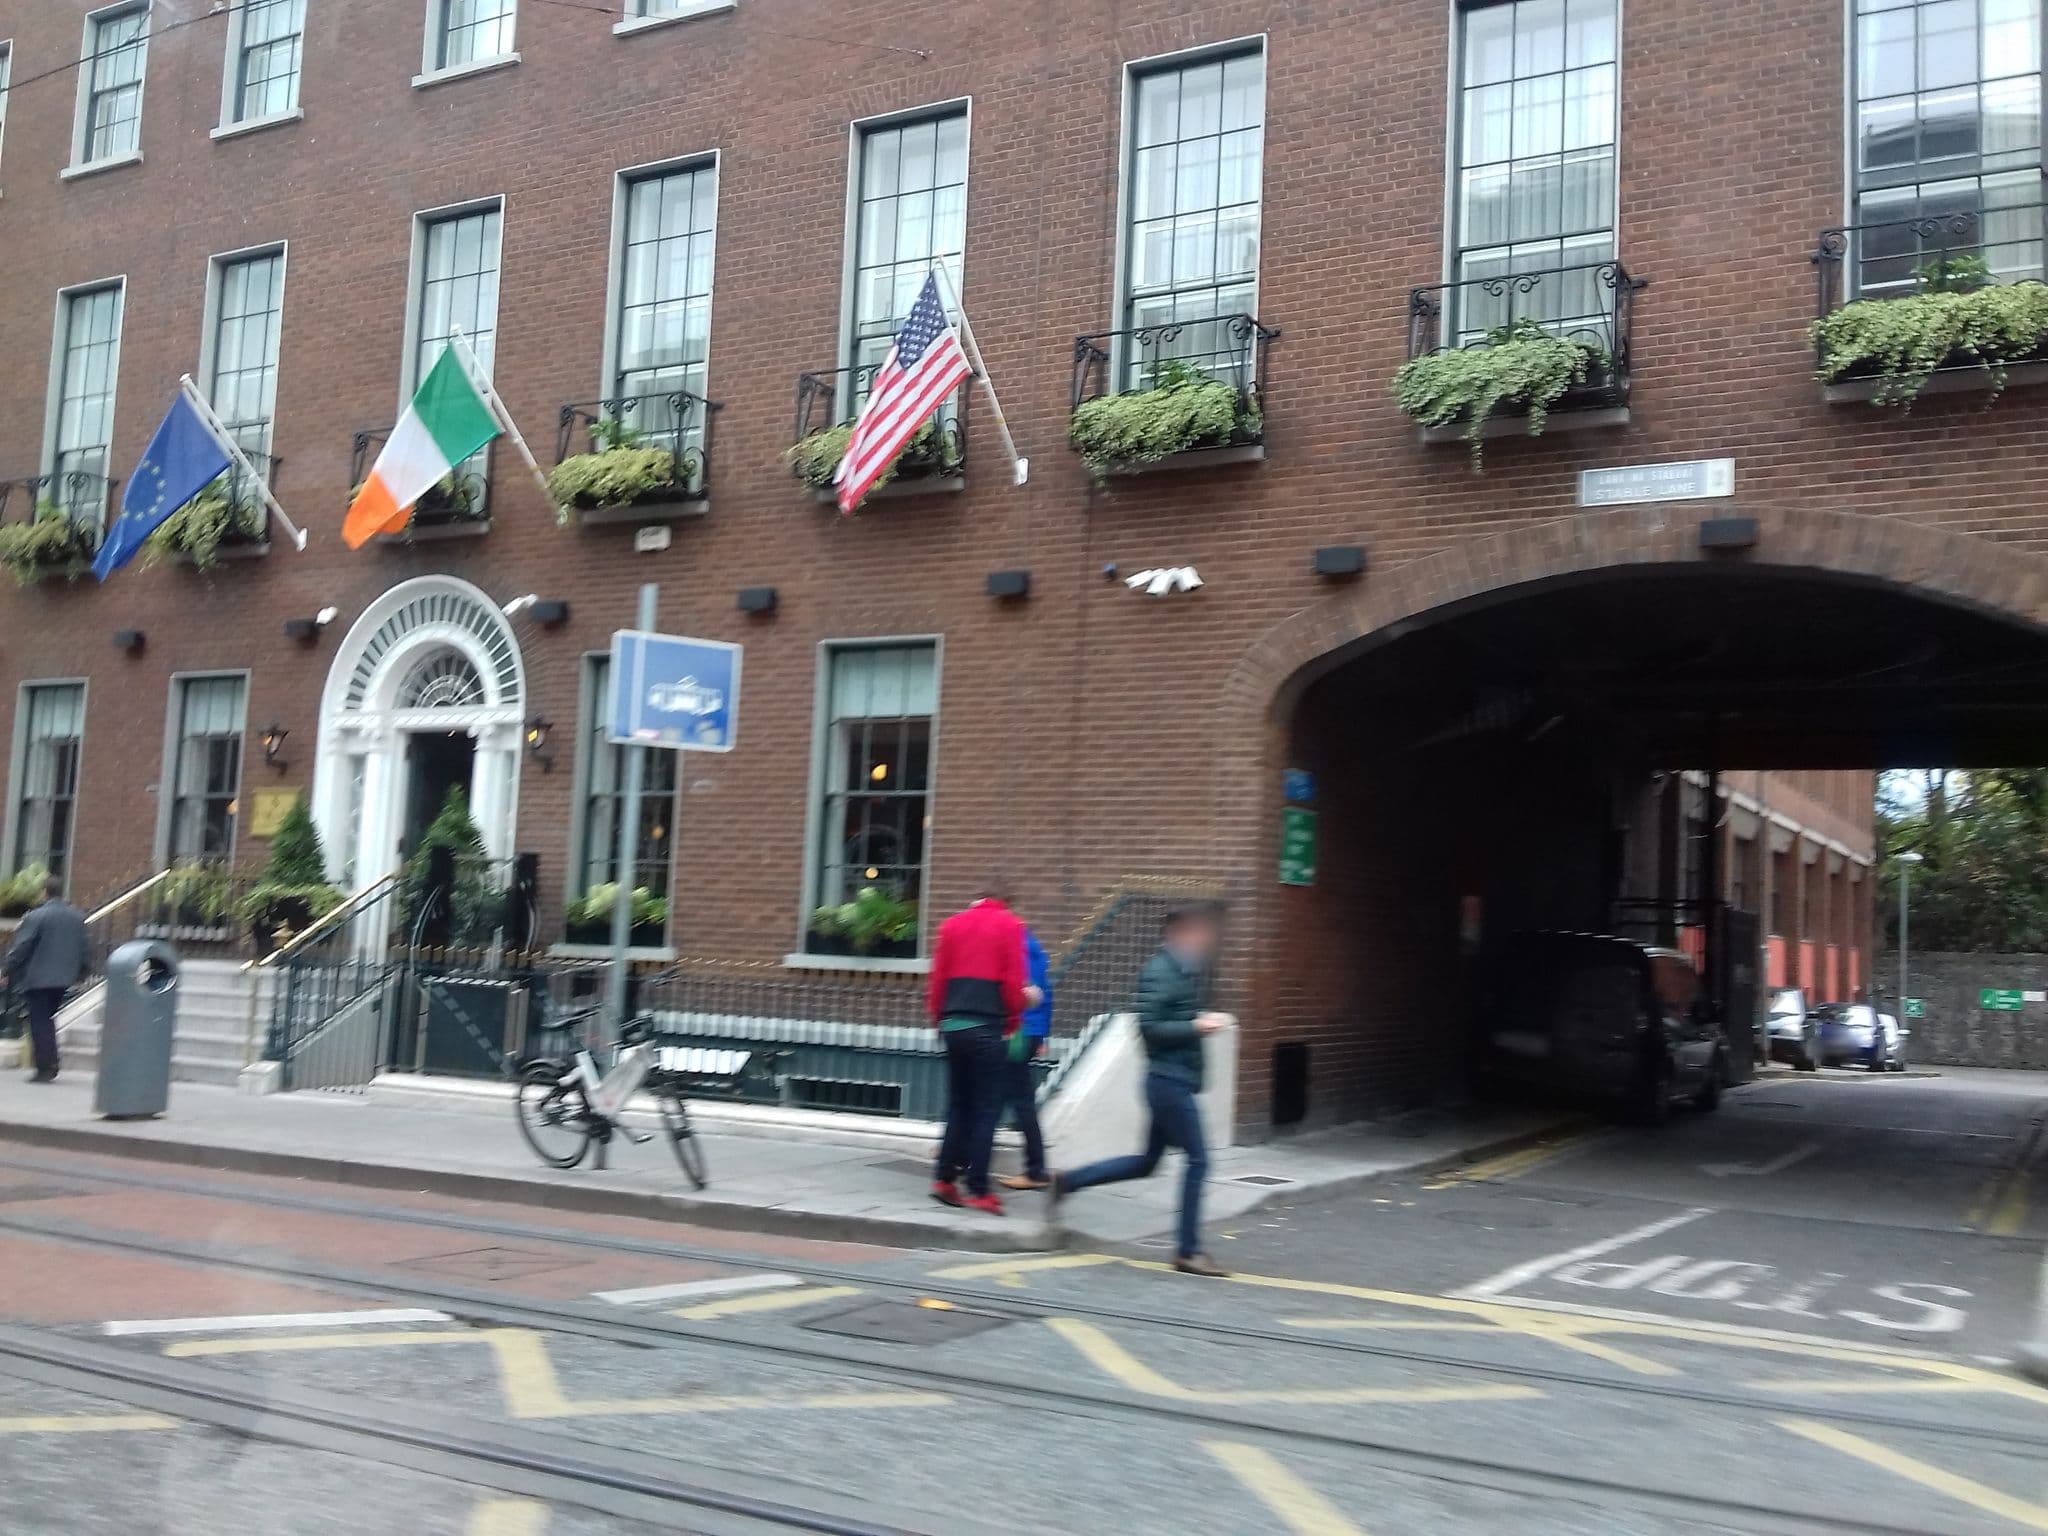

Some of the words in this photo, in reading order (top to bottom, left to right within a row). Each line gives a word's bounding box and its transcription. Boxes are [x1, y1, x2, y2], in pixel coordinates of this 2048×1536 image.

[1595, 486, 1651, 500] STABLE
[1660, 482, 1697, 496] LANE
[1549, 1255, 1975, 1332] STOP
